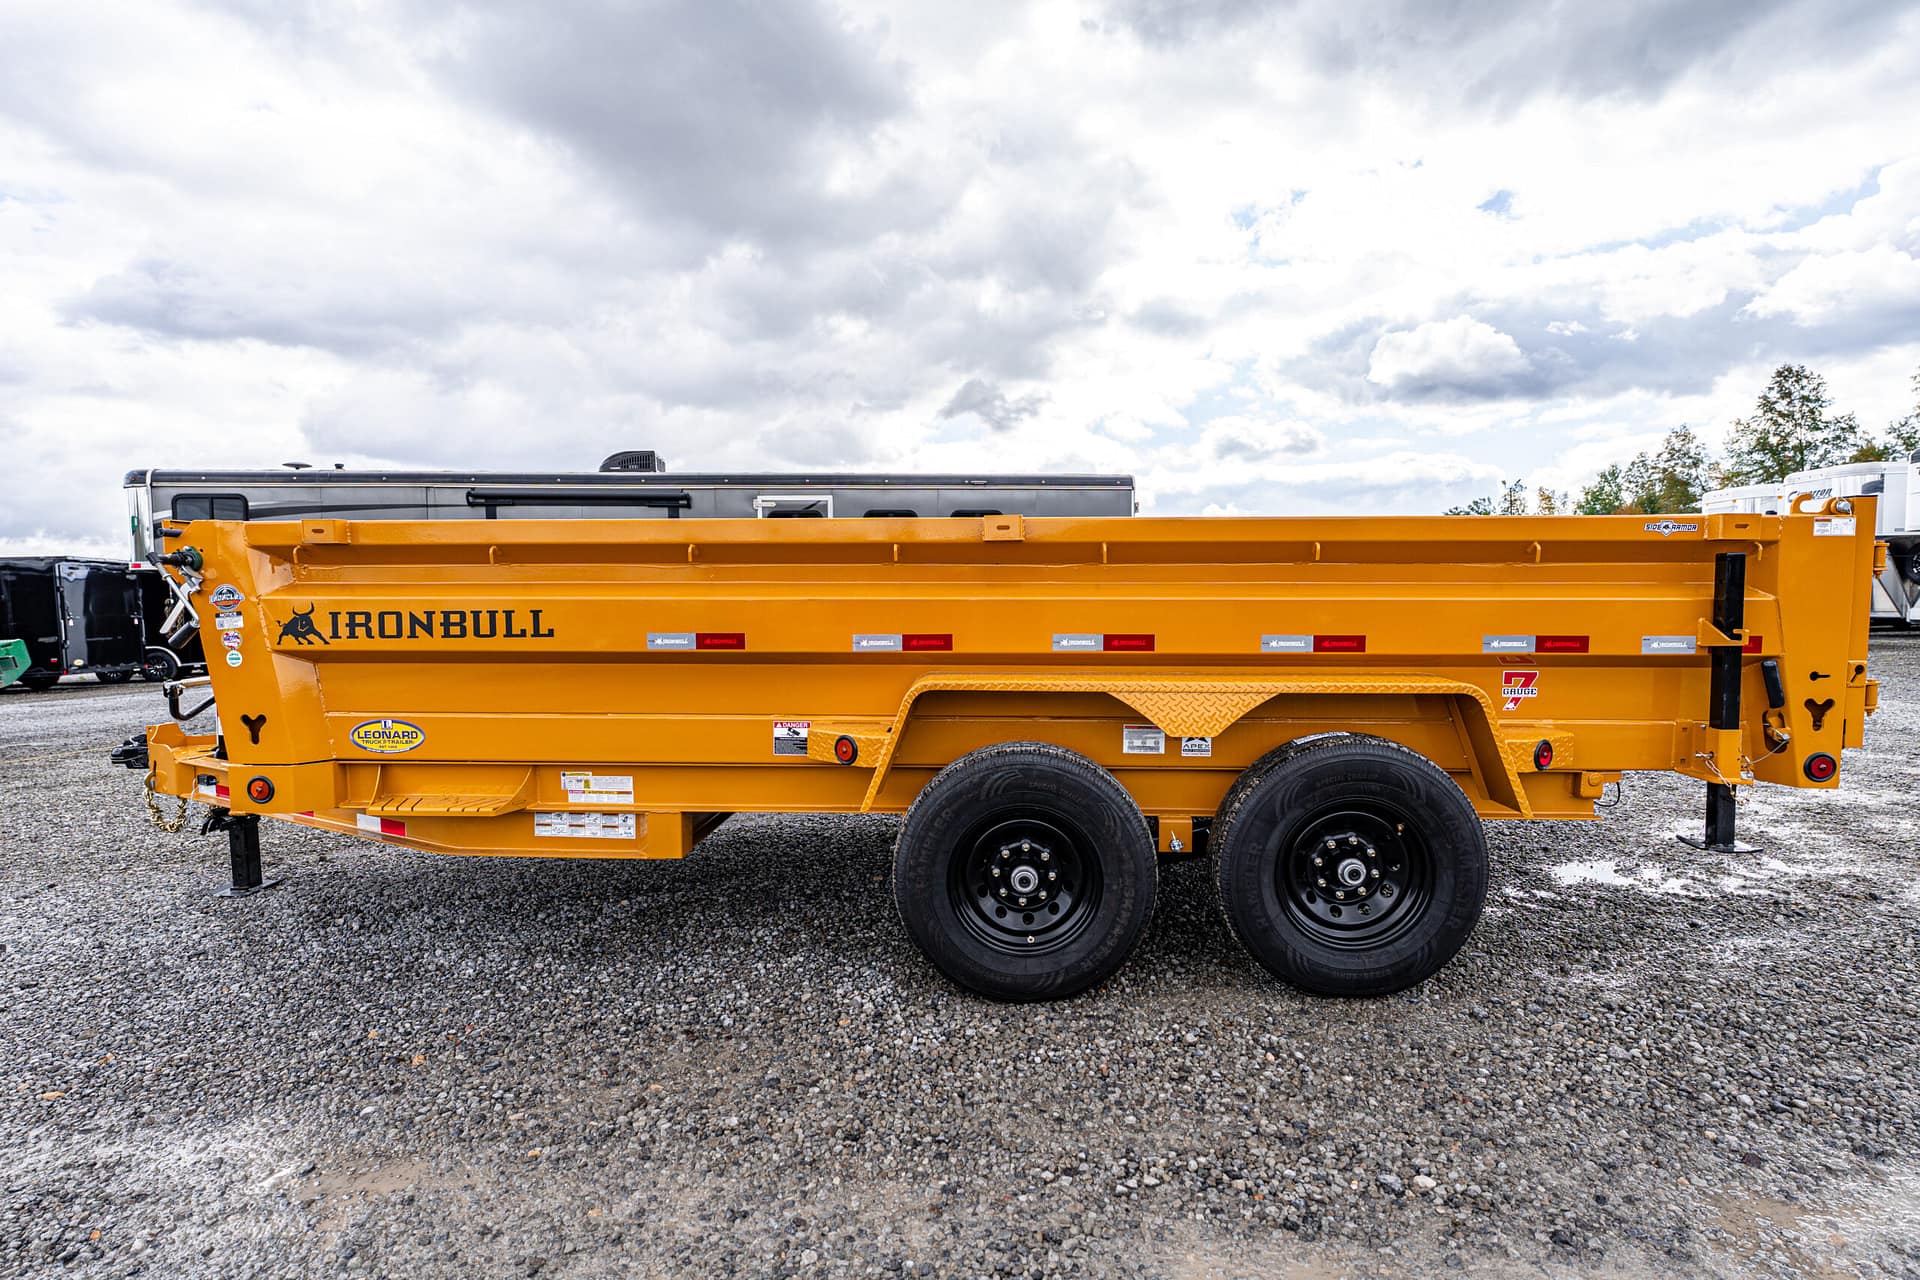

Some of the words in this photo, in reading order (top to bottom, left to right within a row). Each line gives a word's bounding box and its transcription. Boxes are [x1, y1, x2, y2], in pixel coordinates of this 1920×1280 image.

[1788, 488, 1832, 502] Crron
[328, 609, 555, 640] IRONBULL
[357, 730, 418, 739] LEONARD
